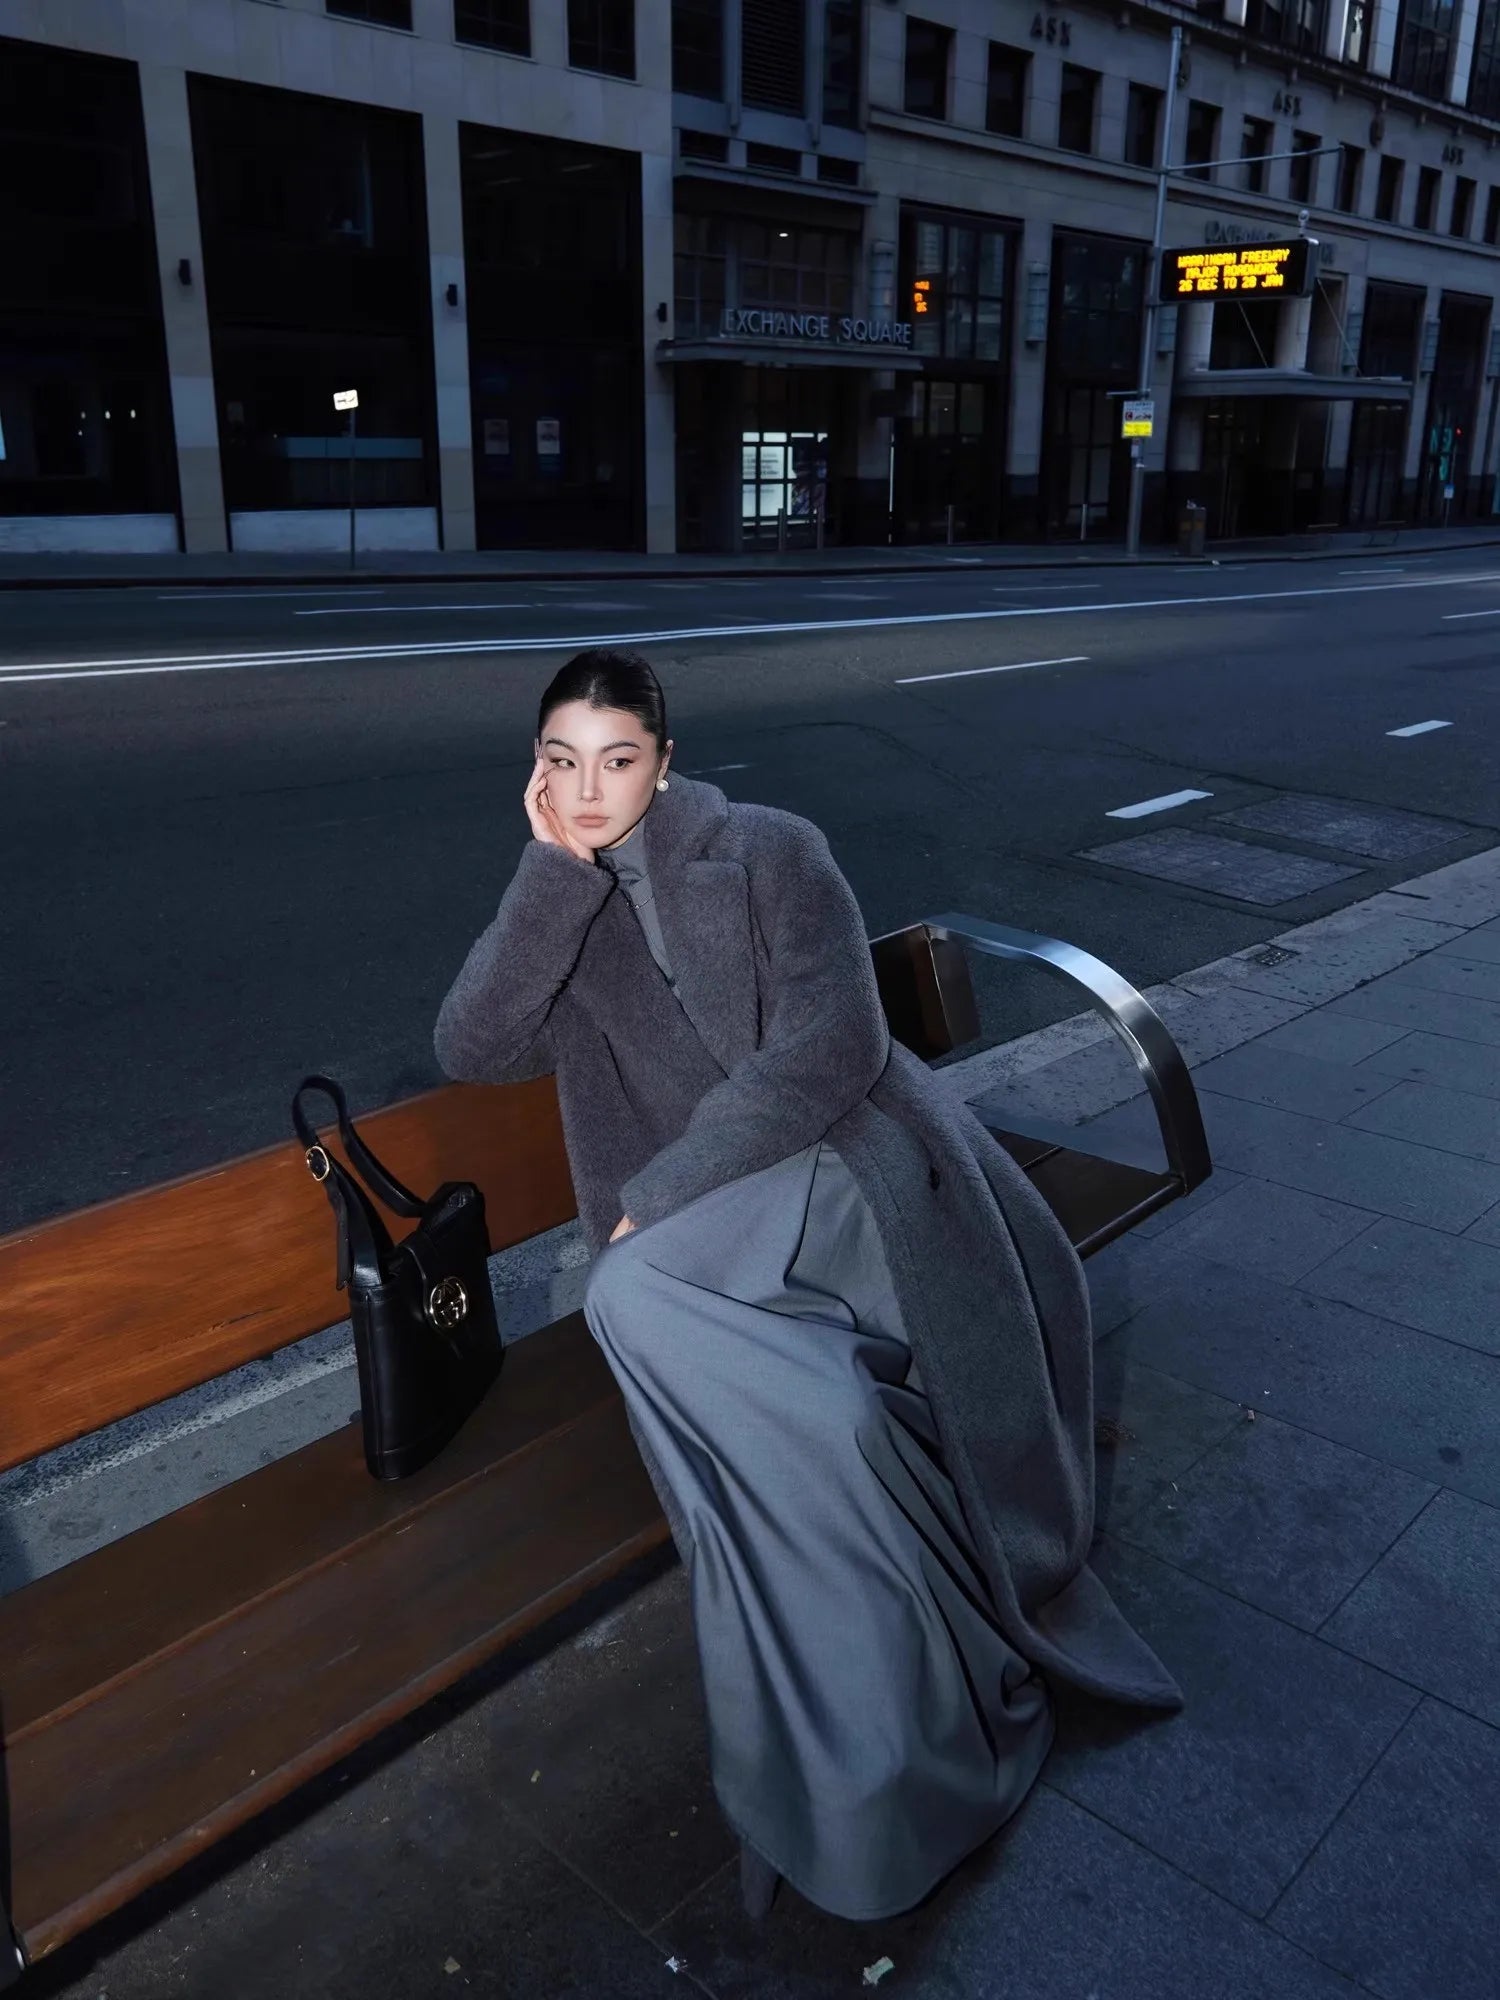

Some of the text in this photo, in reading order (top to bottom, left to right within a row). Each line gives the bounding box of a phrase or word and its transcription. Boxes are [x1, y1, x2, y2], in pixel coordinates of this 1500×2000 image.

[1241, 248, 1290, 264] FREEWAY
[1197, 277, 1218, 290] DEC
[1223, 276, 1237, 289] TO
[1261, 274, 1284, 287] JAN
[724, 308, 912, 345] EXCHANGE SQUARE
